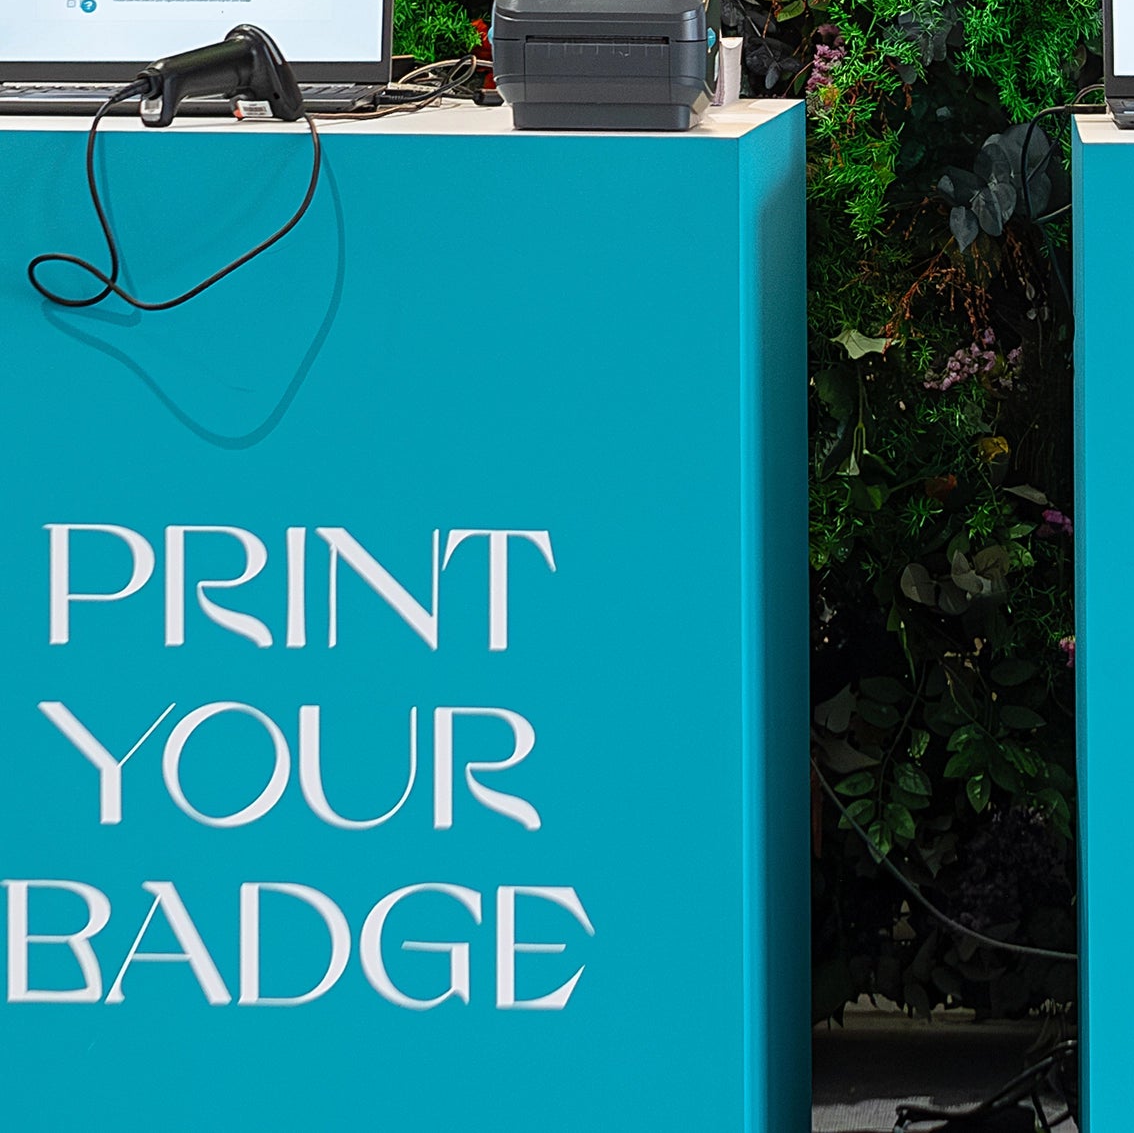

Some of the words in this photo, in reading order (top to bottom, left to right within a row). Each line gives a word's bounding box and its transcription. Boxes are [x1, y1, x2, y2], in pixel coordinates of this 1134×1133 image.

[42, 523, 557, 651] PRINT
[37, 701, 541, 830] YOUR
[0, 879, 596, 1011] BADGE
